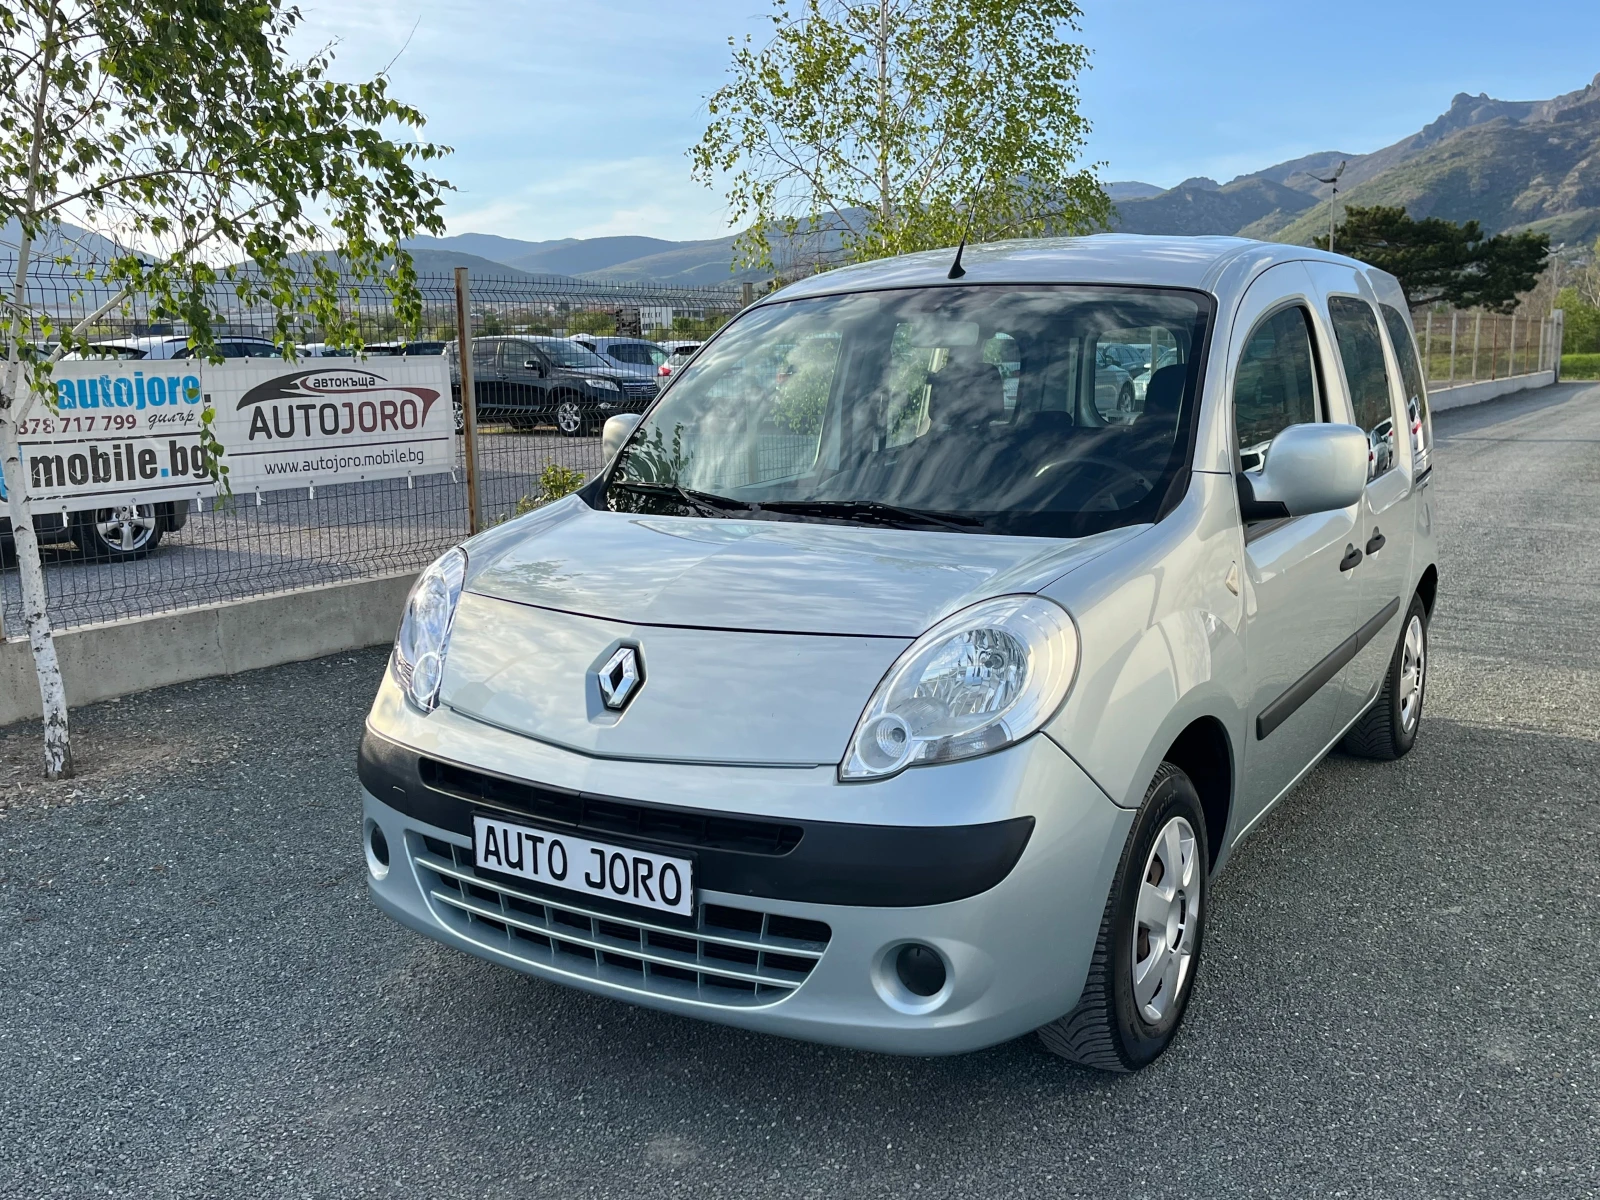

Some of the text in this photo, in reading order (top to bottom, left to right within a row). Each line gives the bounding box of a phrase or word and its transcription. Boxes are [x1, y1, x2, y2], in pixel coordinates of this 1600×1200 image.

[313, 376, 376, 388] автокъща
[60, 416, 96, 433] 717
[101, 414, 137, 431] 799
[249, 399, 418, 441] AUTOJORO
[30, 440, 209, 488] mobile.bg
[265, 448, 424, 475] www.autojoro.mobile.bg
[484, 825, 682, 906] AUTO JORO
